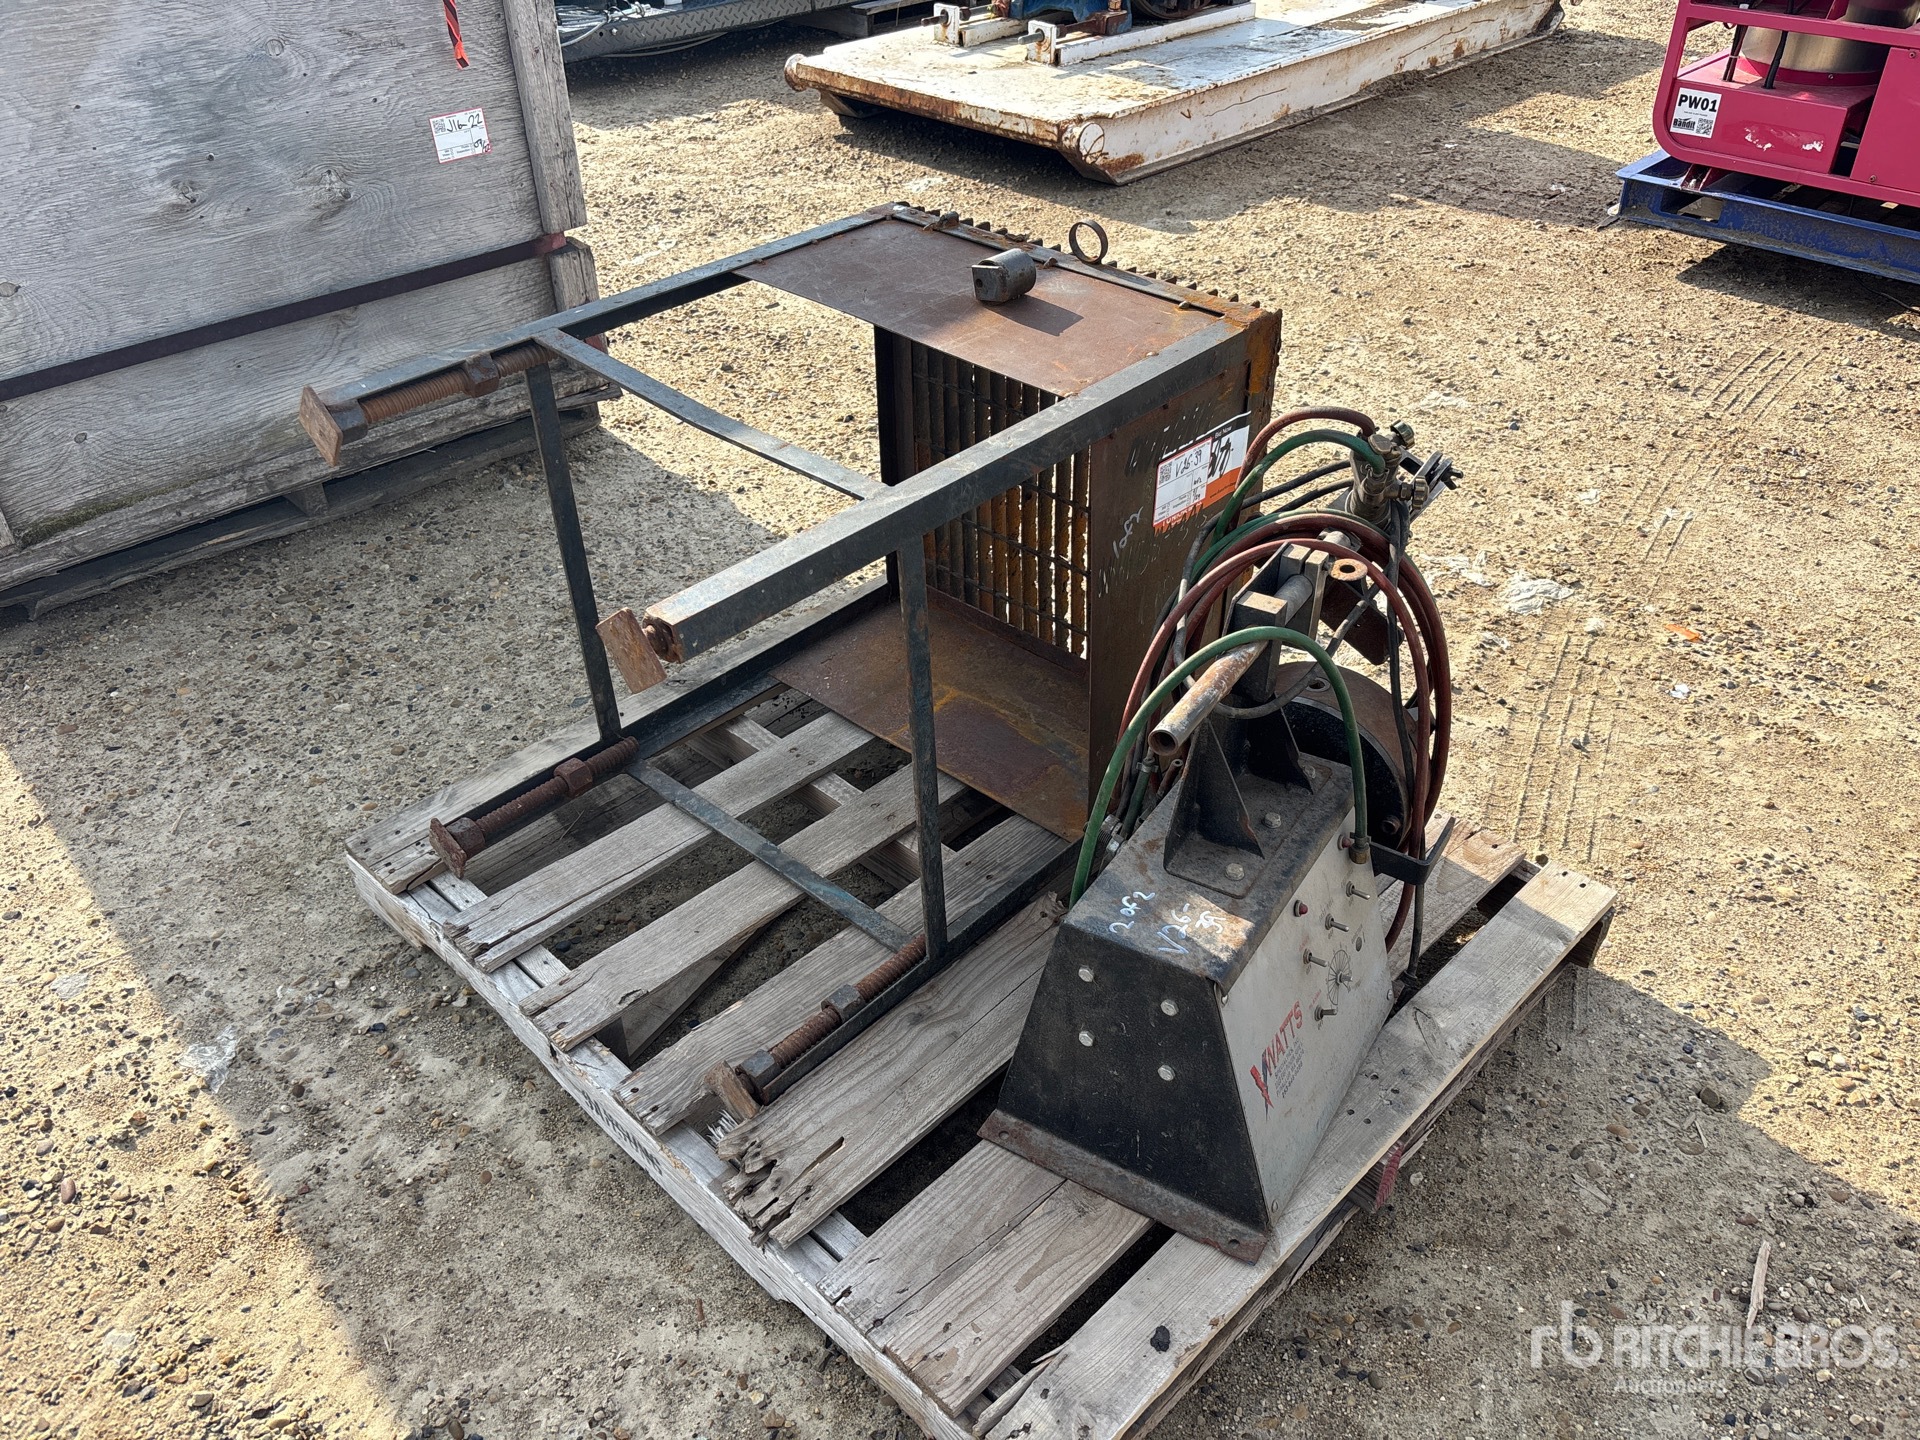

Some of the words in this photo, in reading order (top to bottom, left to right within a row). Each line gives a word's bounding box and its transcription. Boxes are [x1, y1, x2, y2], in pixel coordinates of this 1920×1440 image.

[1678, 94, 1717, 112] PW01
[1673, 118, 1695, 130] Bandit
[1263, 1000, 1303, 1077] WATTS
